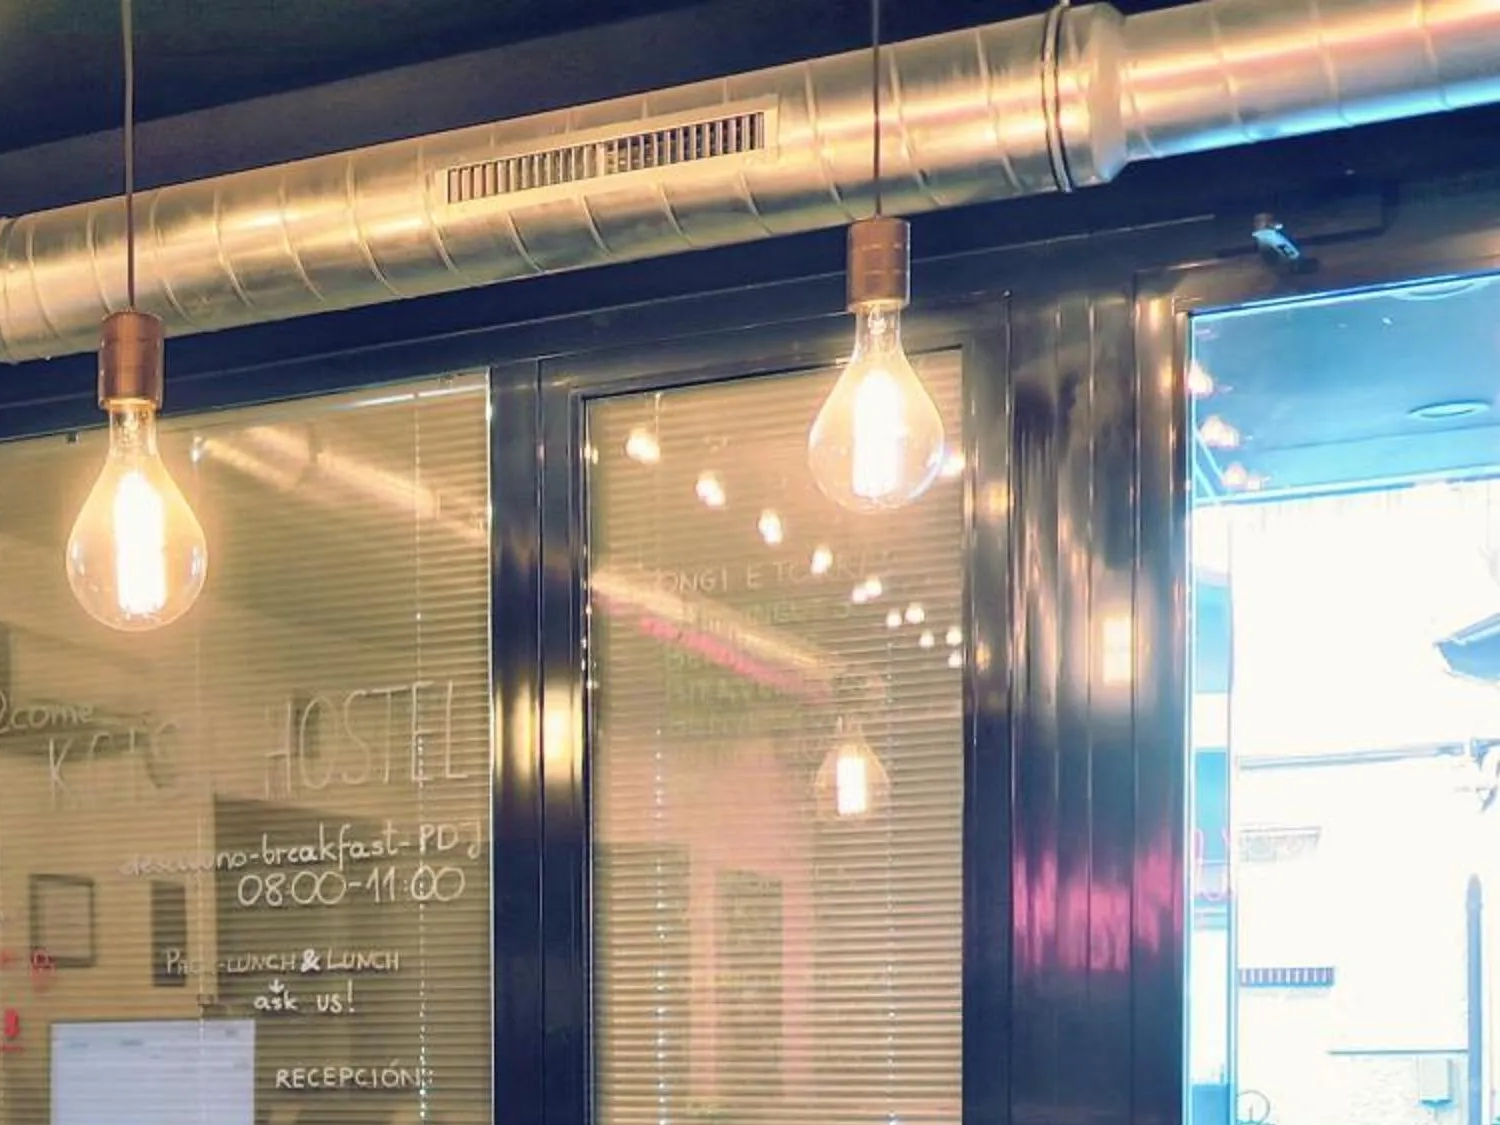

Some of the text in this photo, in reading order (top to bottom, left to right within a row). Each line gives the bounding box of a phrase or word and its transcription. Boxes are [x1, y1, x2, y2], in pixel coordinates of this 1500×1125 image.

[264, 680, 468, 801] HOSTEL
[300, 948, 321, 972] &
[327, 947, 399, 971] LUNCH
[253, 990, 298, 1011] ask
